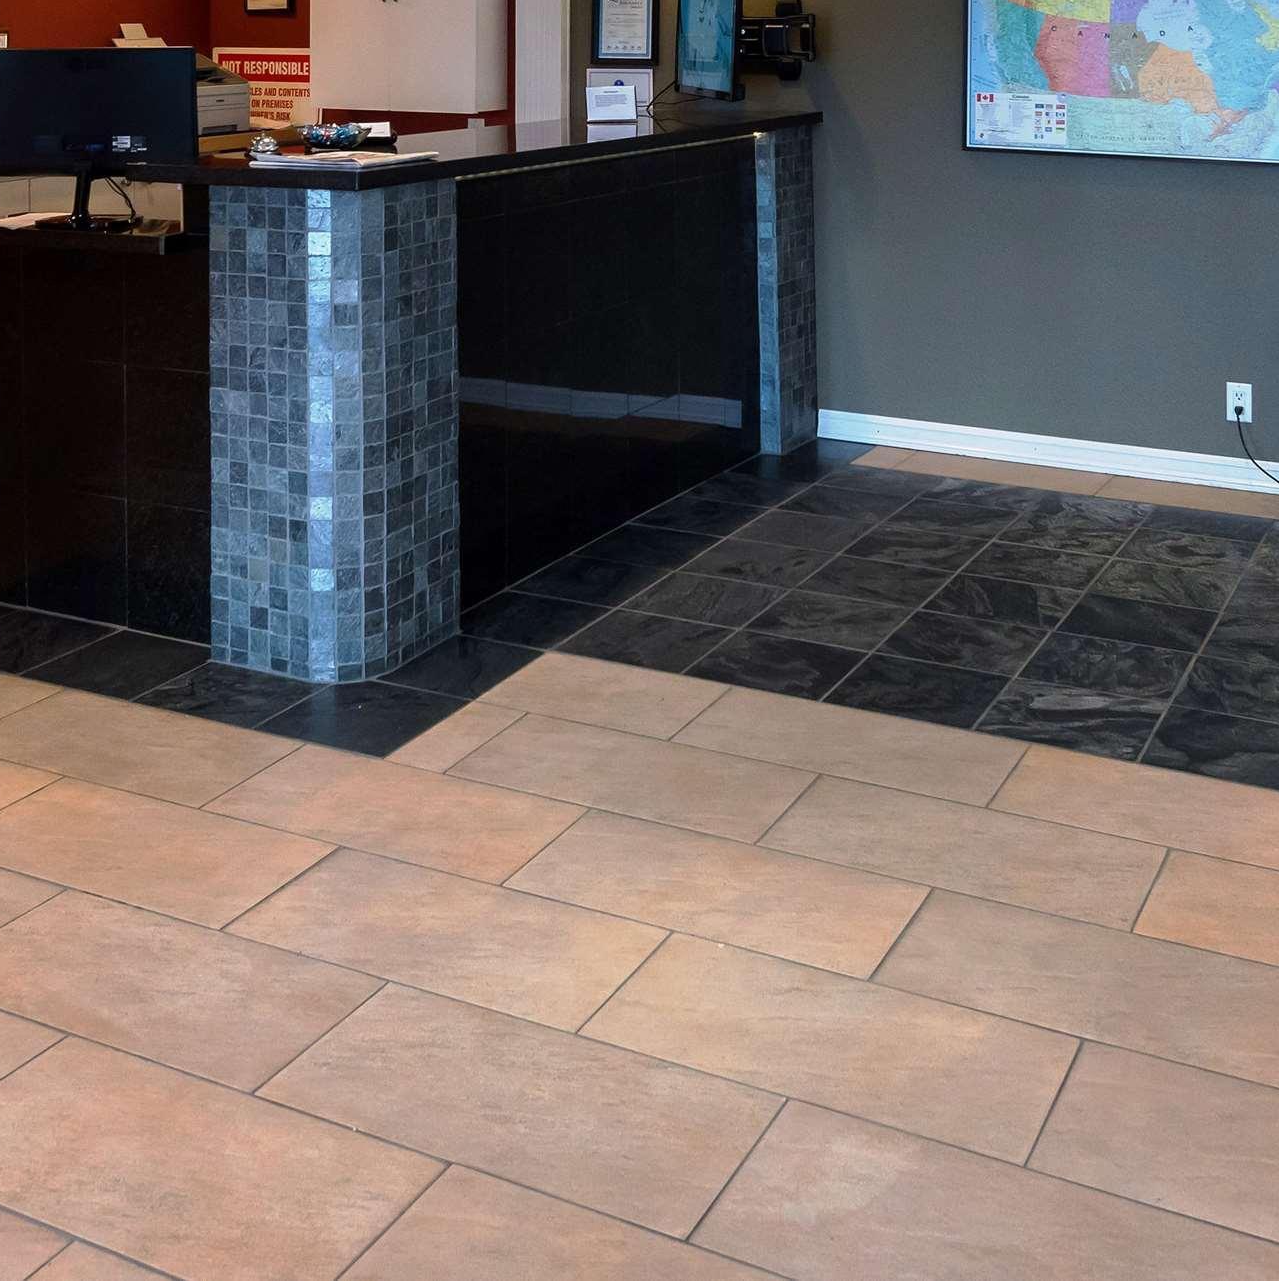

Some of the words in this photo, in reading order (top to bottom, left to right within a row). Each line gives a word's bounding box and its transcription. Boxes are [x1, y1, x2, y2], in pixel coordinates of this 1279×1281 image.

[222, 61, 241, 74] NOT
[243, 61, 309, 75] RESPONSIBLE
[264, 88, 277, 97] AND
[279, 88, 310, 97] CONTENTS
[251, 100, 260, 108] ON
[261, 99, 294, 109] PREMISES
[276, 112, 291, 121] RISK
